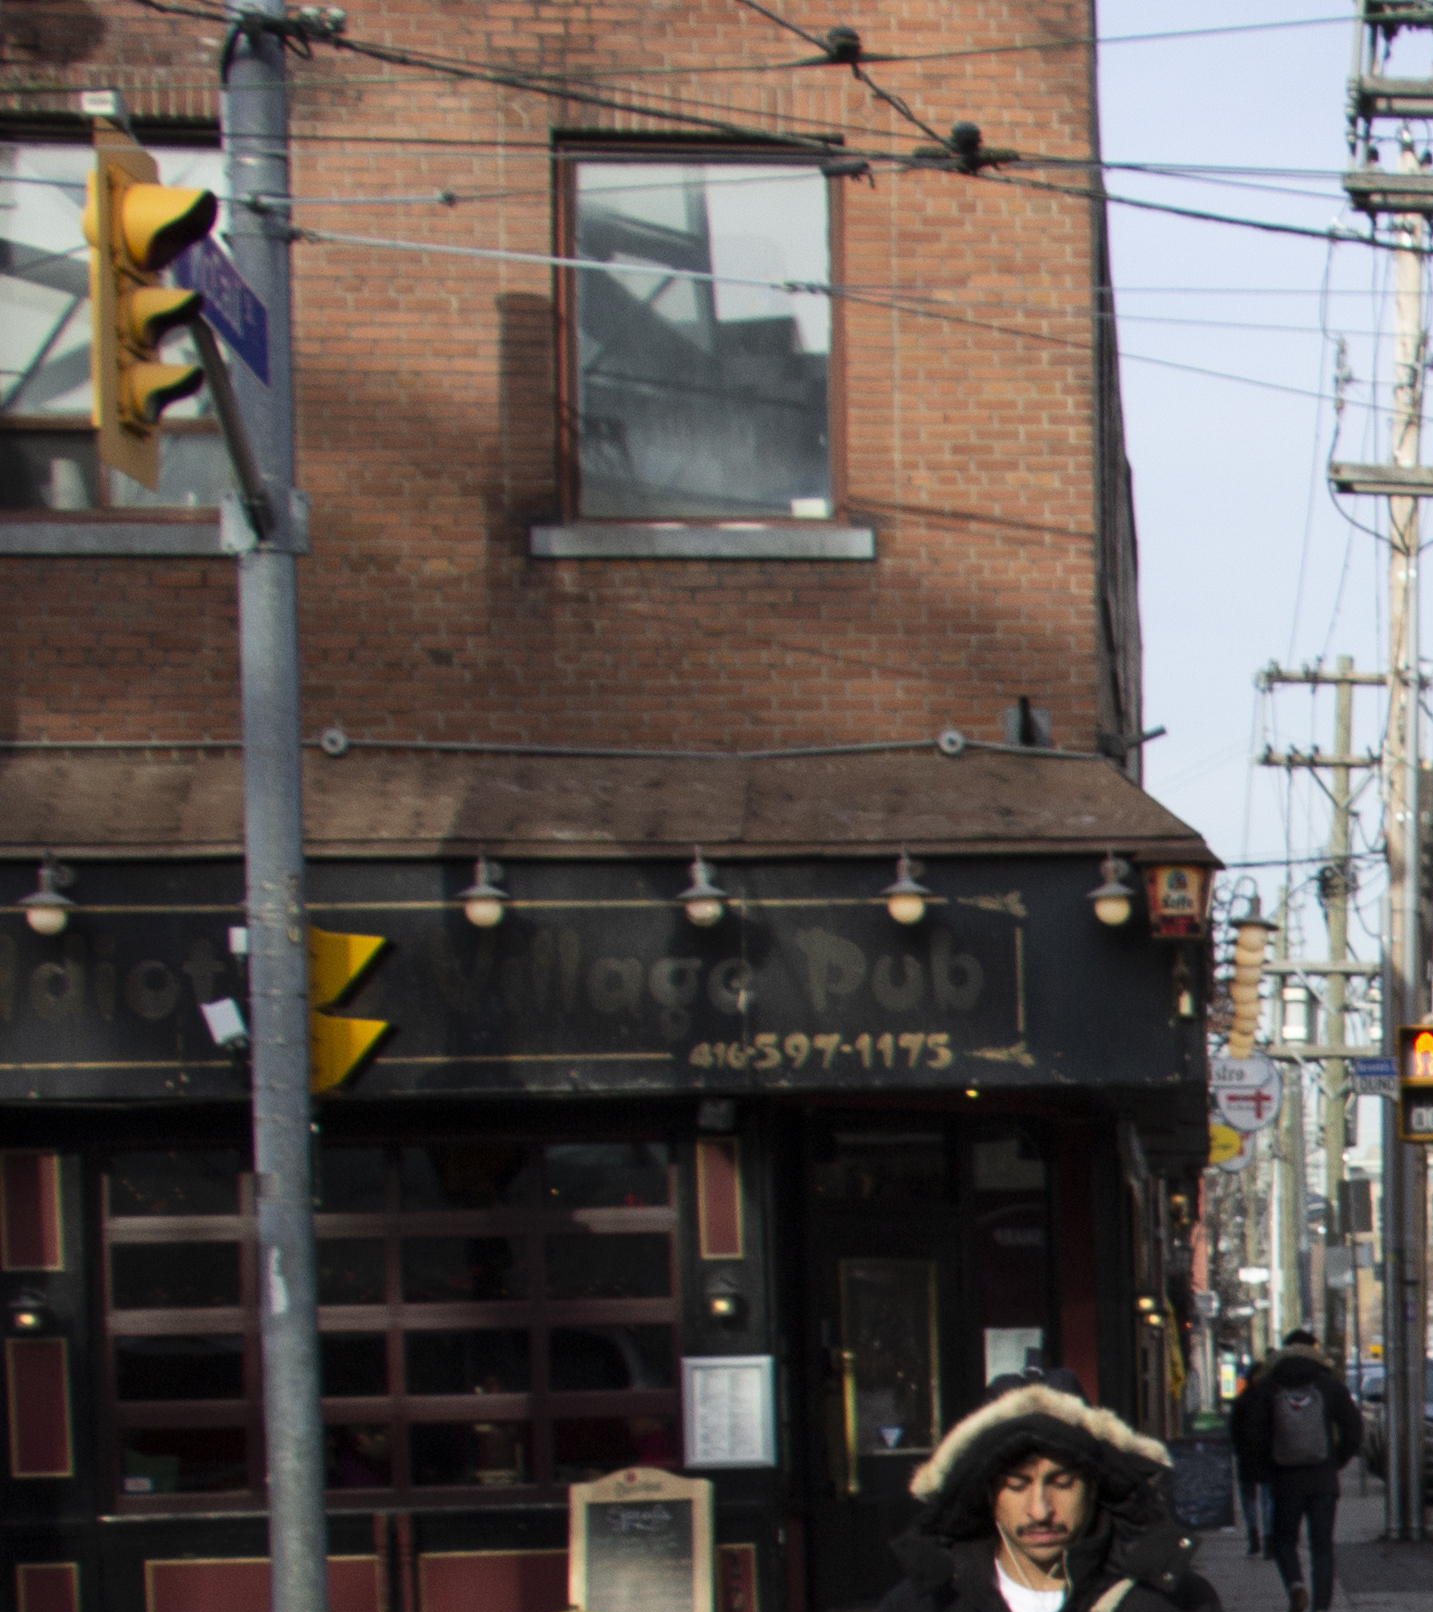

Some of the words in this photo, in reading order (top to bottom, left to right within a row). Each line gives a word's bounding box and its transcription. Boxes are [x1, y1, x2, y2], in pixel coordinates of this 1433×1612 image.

[430, 927, 754, 1040] Village
[797, 927, 985, 1013] Pub
[688, 1032, 954, 1070] 416-597-1175
